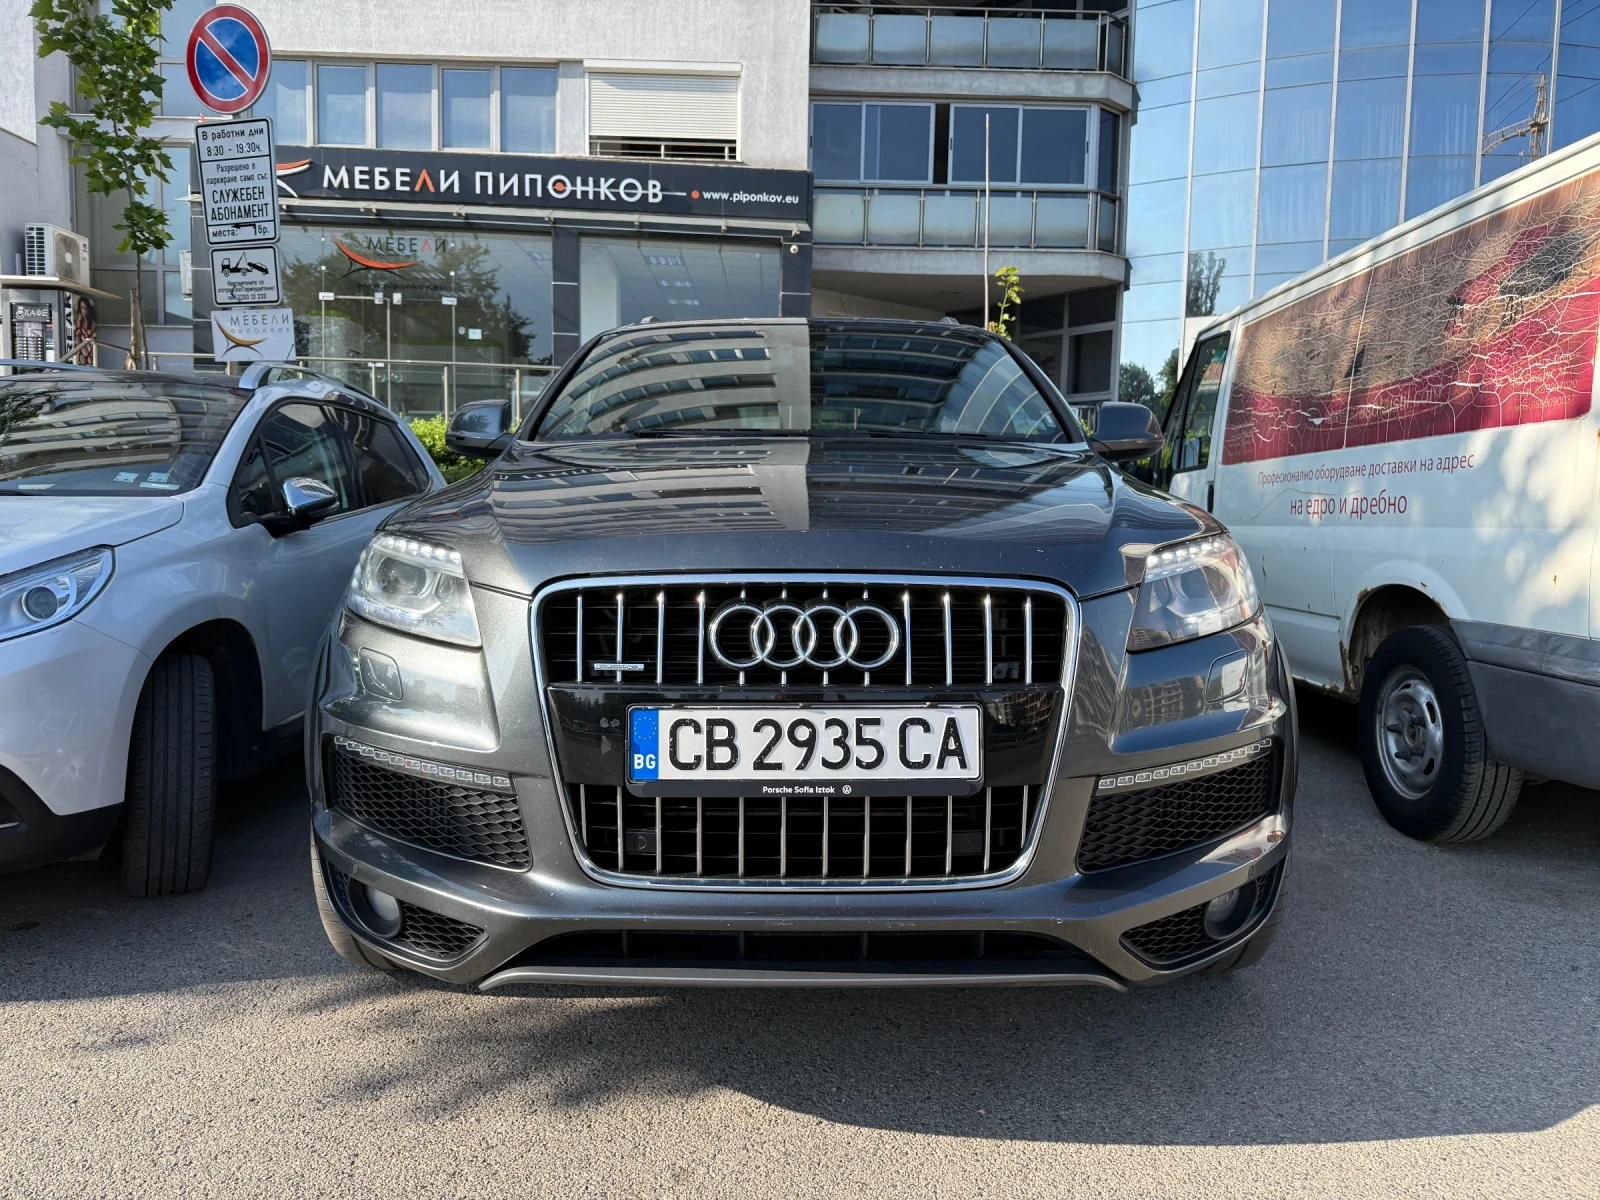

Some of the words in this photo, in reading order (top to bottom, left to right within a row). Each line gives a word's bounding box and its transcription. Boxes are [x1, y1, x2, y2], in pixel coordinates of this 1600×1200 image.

[202, 131, 208, 141] В
[211, 129, 245, 142] работни
[248, 128, 264, 137] дни
[207, 145, 224, 156] 8:30
[217, 163, 249, 174] Разрешено
[206, 175, 237, 186] паркиране
[240, 174, 254, 182] само
[257, 172, 268, 180] със
[323, 165, 460, 194] МЕБЕЛИ
[475, 171, 663, 203] ПИПОНКОВ
[212, 186, 264, 204] СЛУЖЕБЕН
[702, 190, 799, 204] www.piponkov.eu
[211, 203, 269, 221] АБОНАМЕНТ
[212, 228, 238, 237] места:
[367, 236, 446, 253] МЕБЕЛИ
[357, 282, 446, 291] www.piponkov.eu
[24, 308, 48, 317] КАФЕ
[230, 314, 289, 326] МЕБЕЛИ
[1258, 469, 1314, 488] Професионално
[1315, 464, 1367, 482] оборудване
[1368, 460, 1417, 479] доставки
[1420, 458, 1434, 471] на
[1436, 454, 1475, 474] адрес
[1290, 499, 1303, 515] на
[1306, 498, 1336, 520] едро
[1340, 498, 1347, 514] и
[1350, 488, 1408, 520] дребно
[633, 753, 656, 770] BG
[669, 718, 739, 771] CB
[752, 718, 885, 771] 2935
[898, 717, 968, 770] CA
[762, 786, 793, 794] Porsche
[794, 786, 814, 794] Sofia
[815, 786, 835, 794] Iztok
